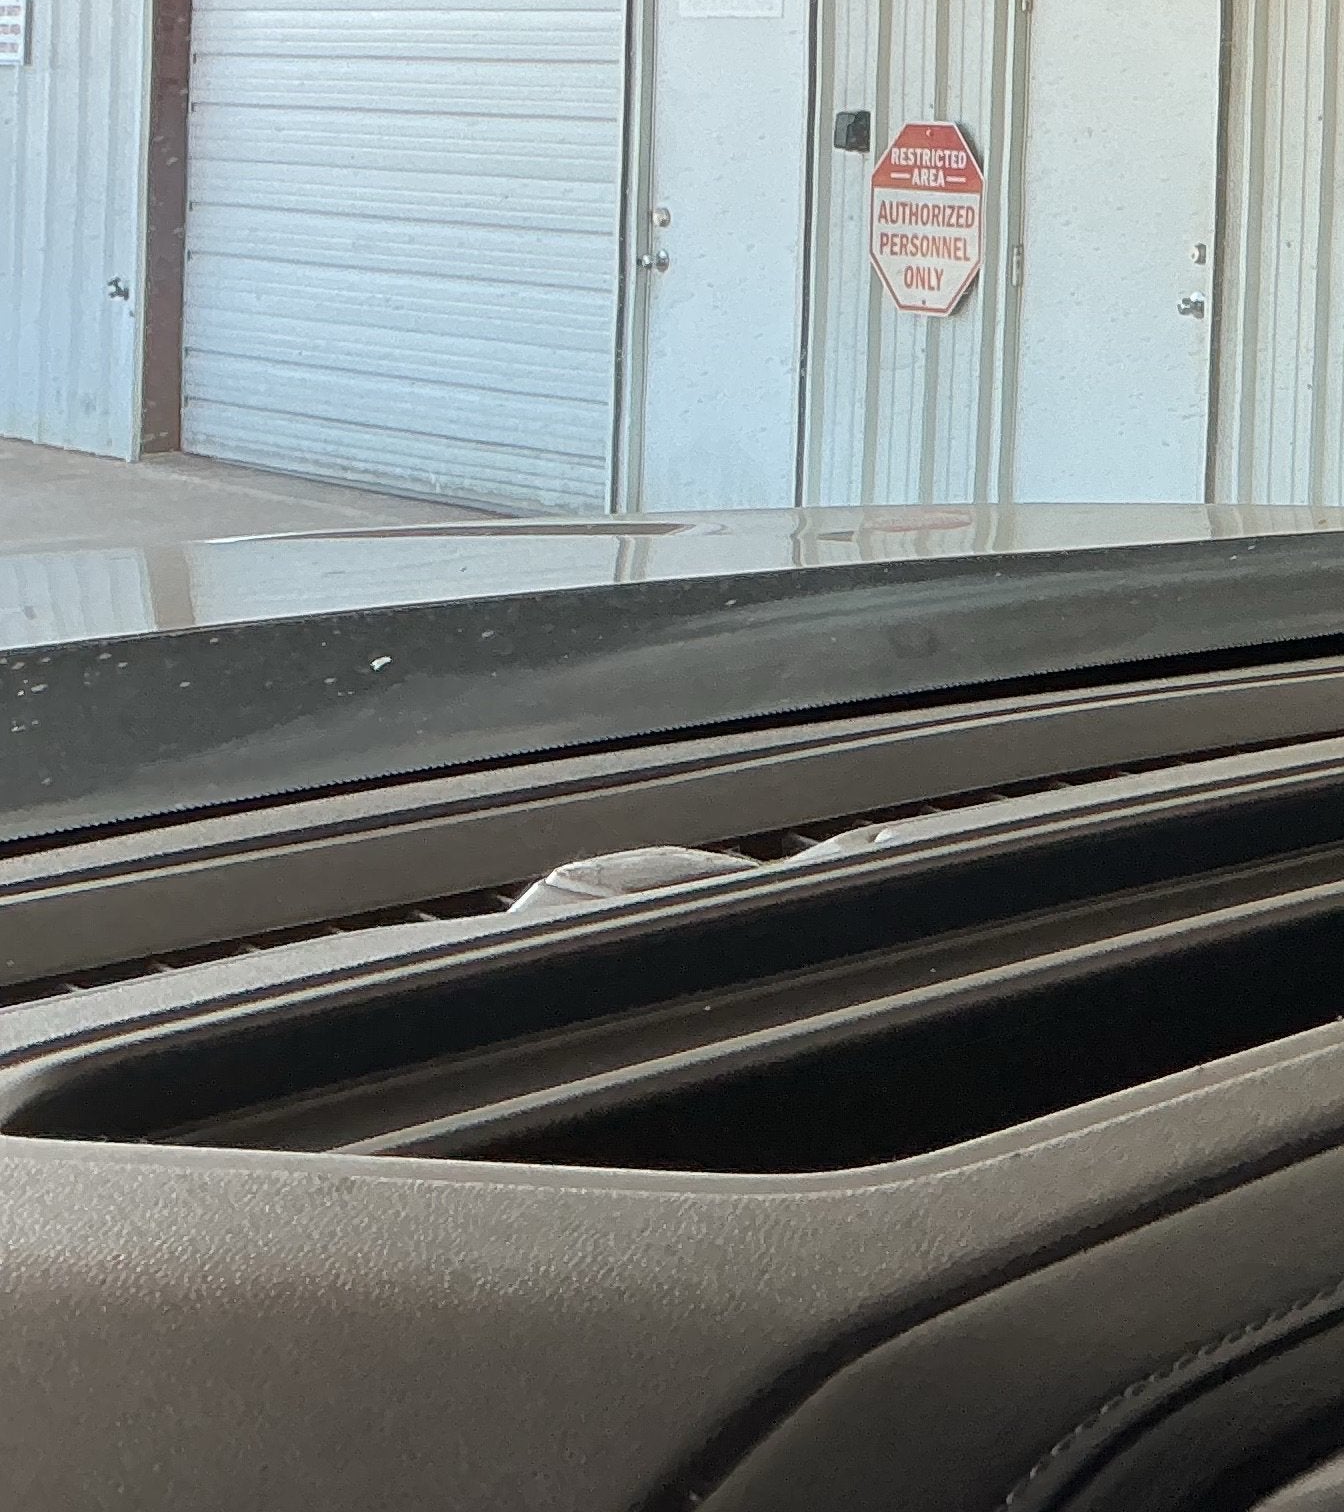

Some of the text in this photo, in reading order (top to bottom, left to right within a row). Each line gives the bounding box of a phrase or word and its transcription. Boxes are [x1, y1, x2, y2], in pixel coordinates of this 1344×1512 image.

[891, 147, 966, 169] RESTRICTED
[912, 170, 945, 188] AREA
[878, 199, 976, 229] AUTHORIZED
[879, 232, 971, 262] PERSONNEL
[904, 265, 944, 292] ONLY
